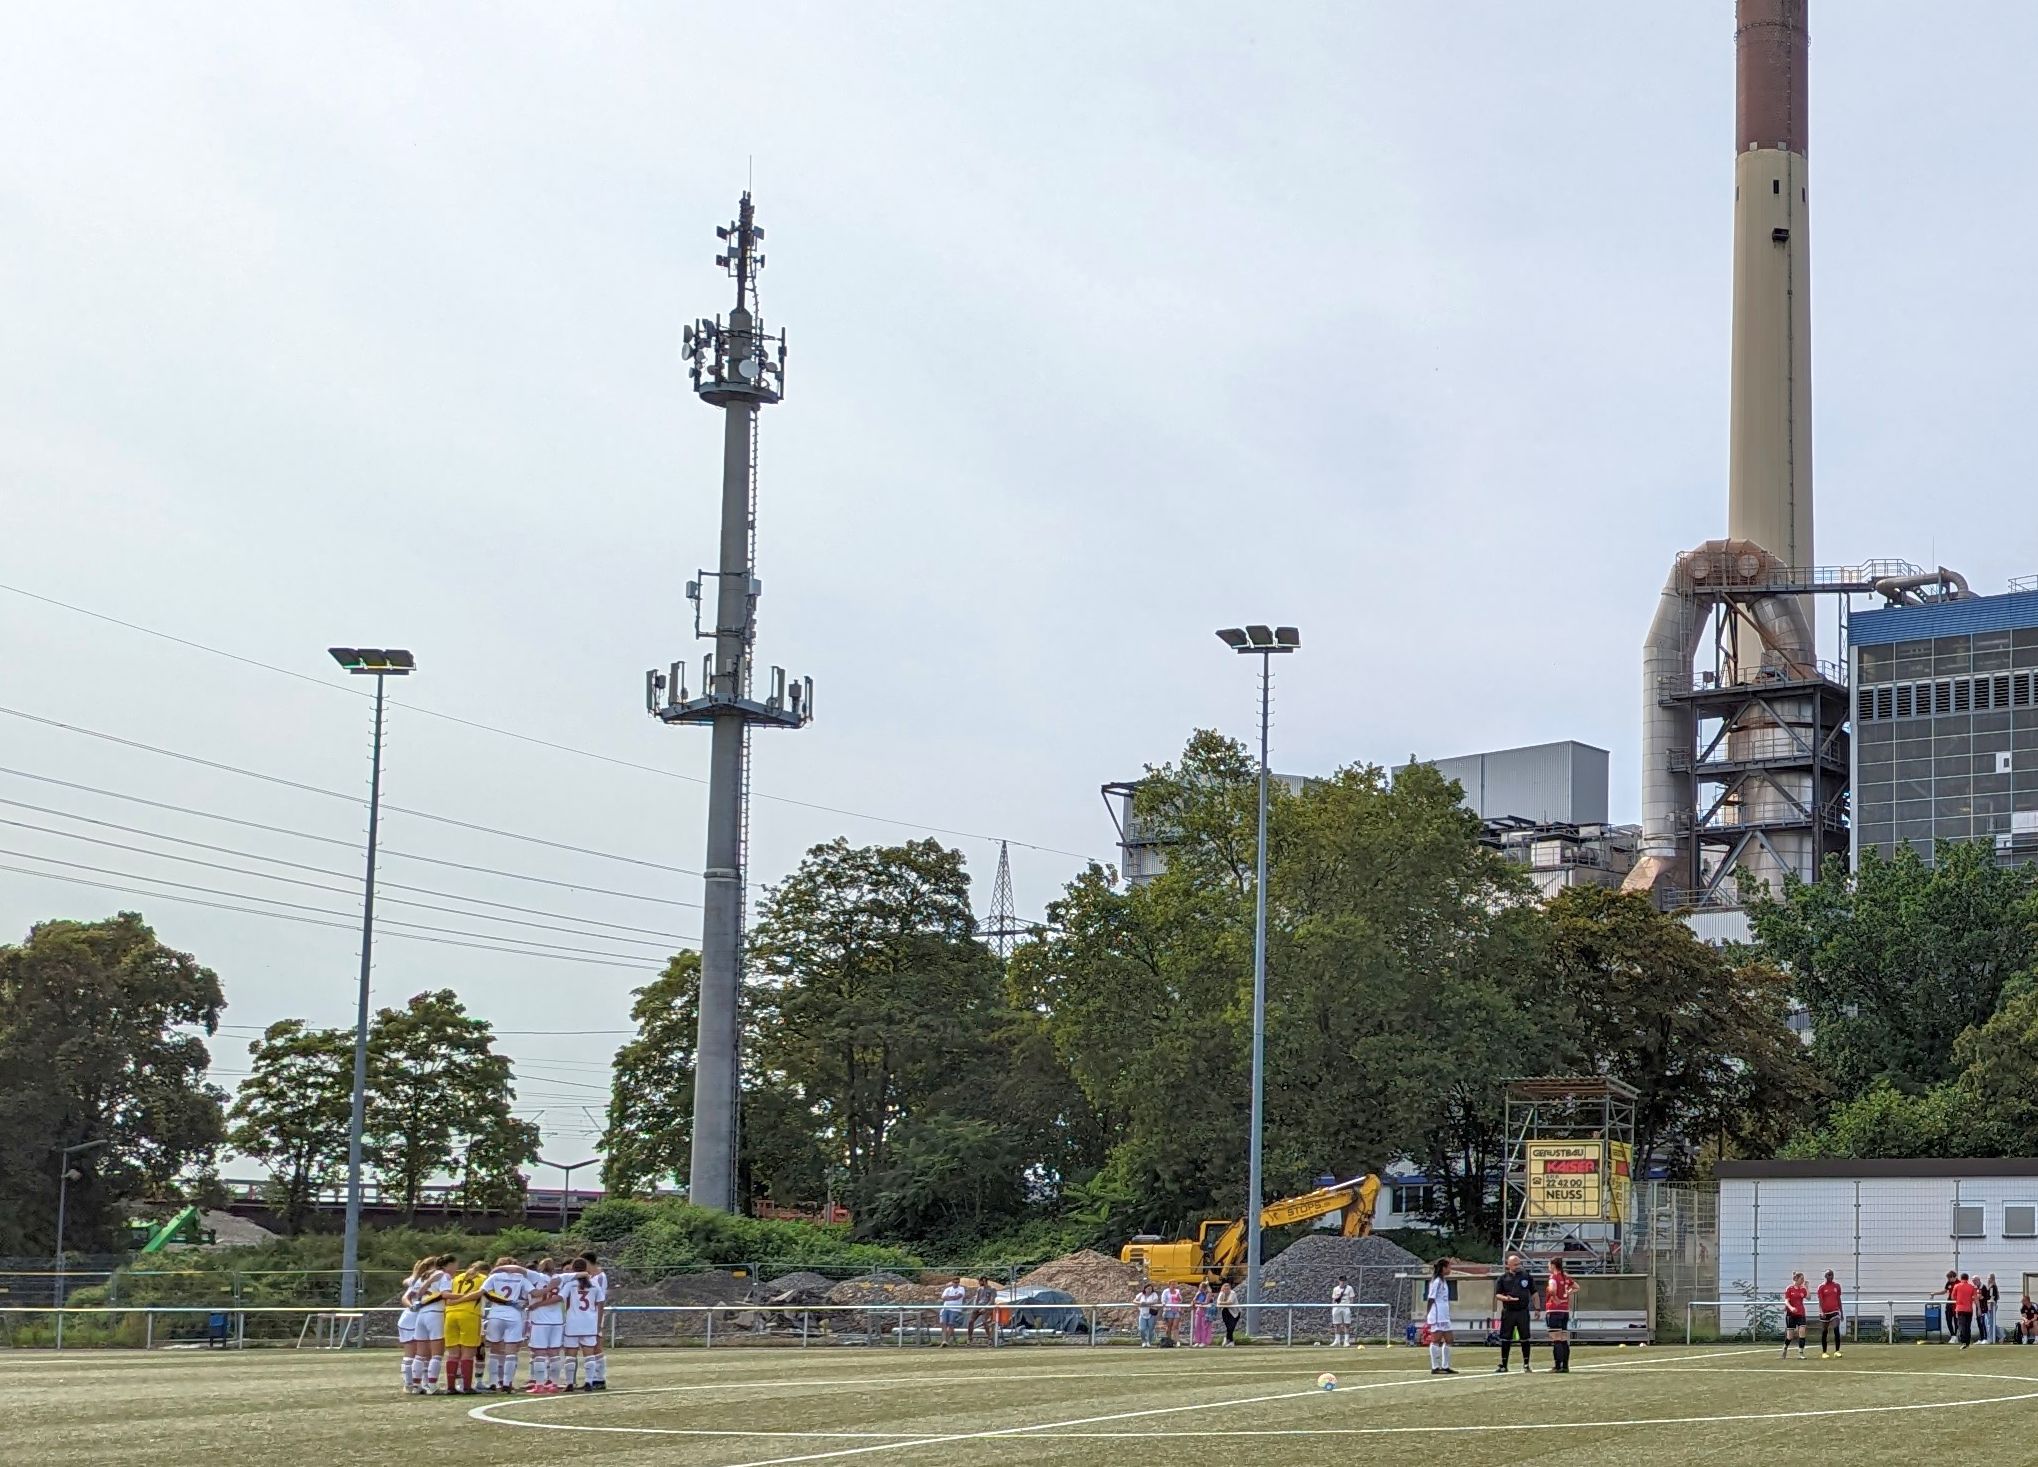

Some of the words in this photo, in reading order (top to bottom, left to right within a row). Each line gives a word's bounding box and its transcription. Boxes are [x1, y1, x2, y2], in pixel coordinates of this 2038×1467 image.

[1547, 1161, 1595, 1173] KAISER
[1546, 1190, 1582, 1199] NEUSS
[457, 1280, 475, 1294] 12
[501, 1285, 513, 1299] 2
[577, 1290, 590, 1311] 3
